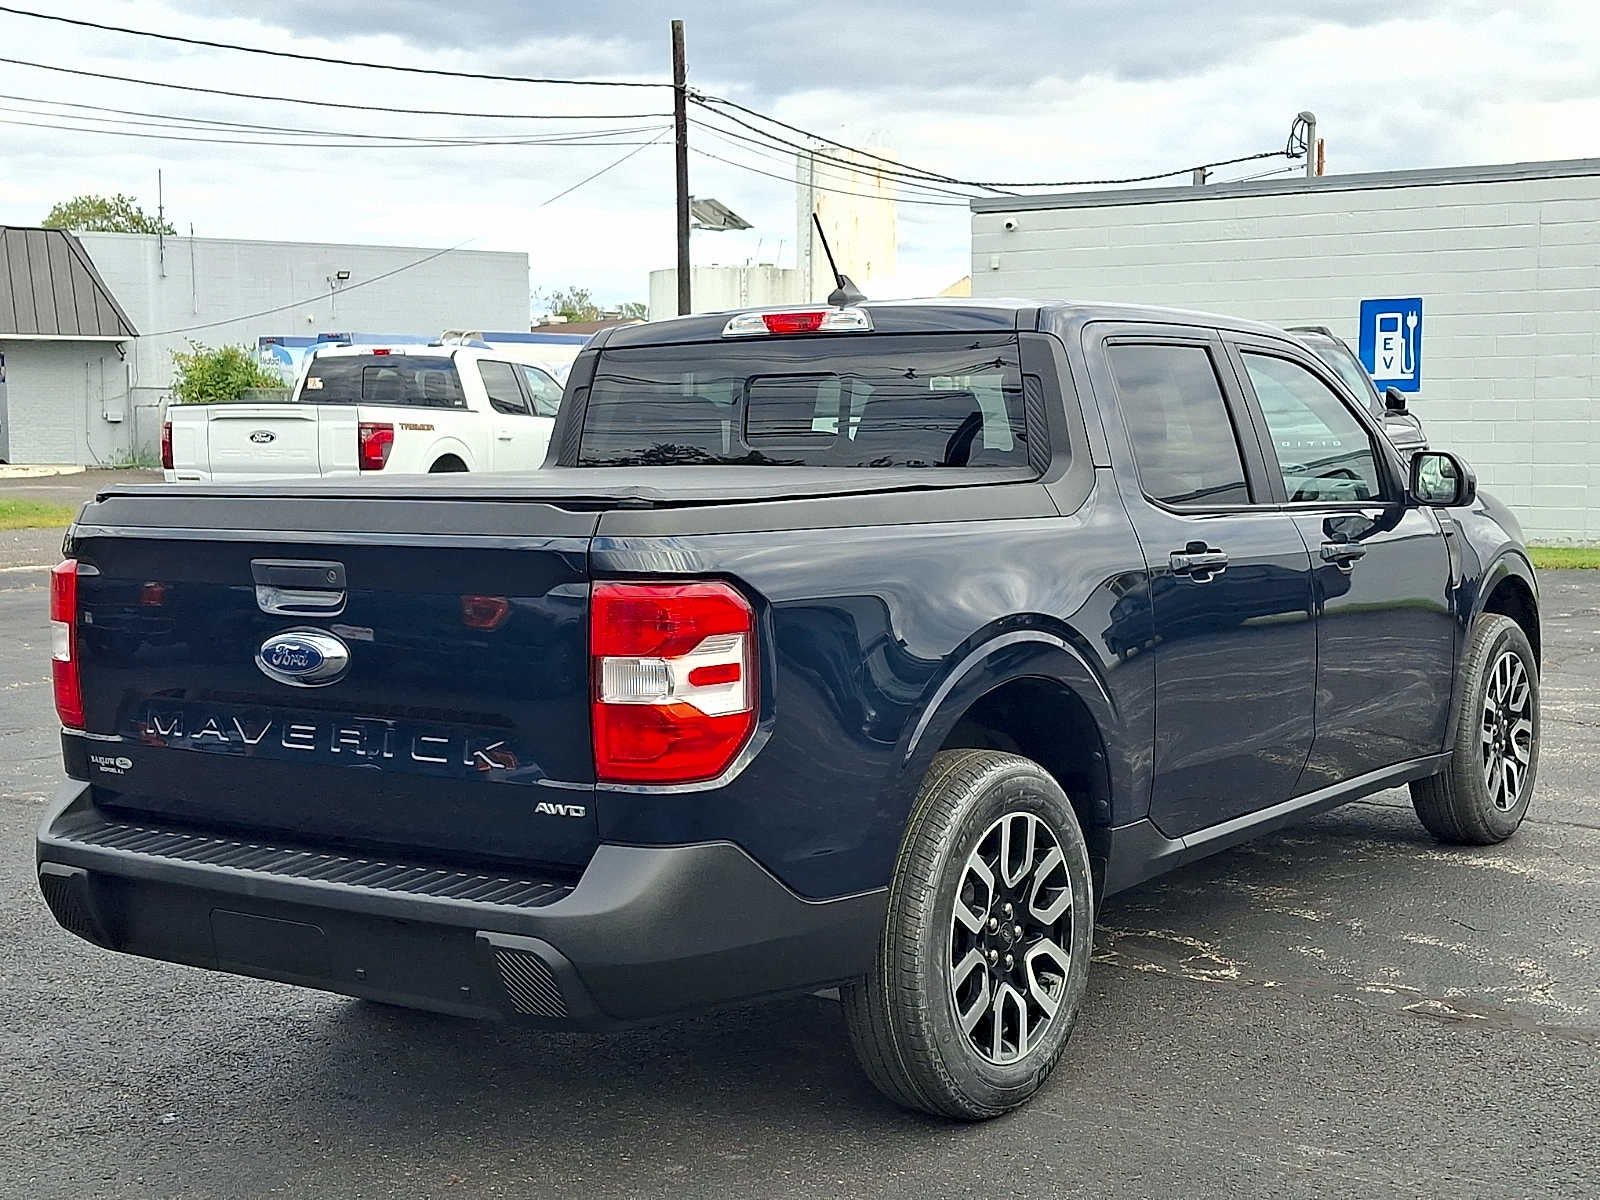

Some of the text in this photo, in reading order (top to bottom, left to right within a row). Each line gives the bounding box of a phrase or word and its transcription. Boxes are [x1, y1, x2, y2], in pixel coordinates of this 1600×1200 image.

[271, 643, 310, 667] Ford
[145, 710, 505, 768] MAVERICK
[534, 802, 586, 817] AWD
